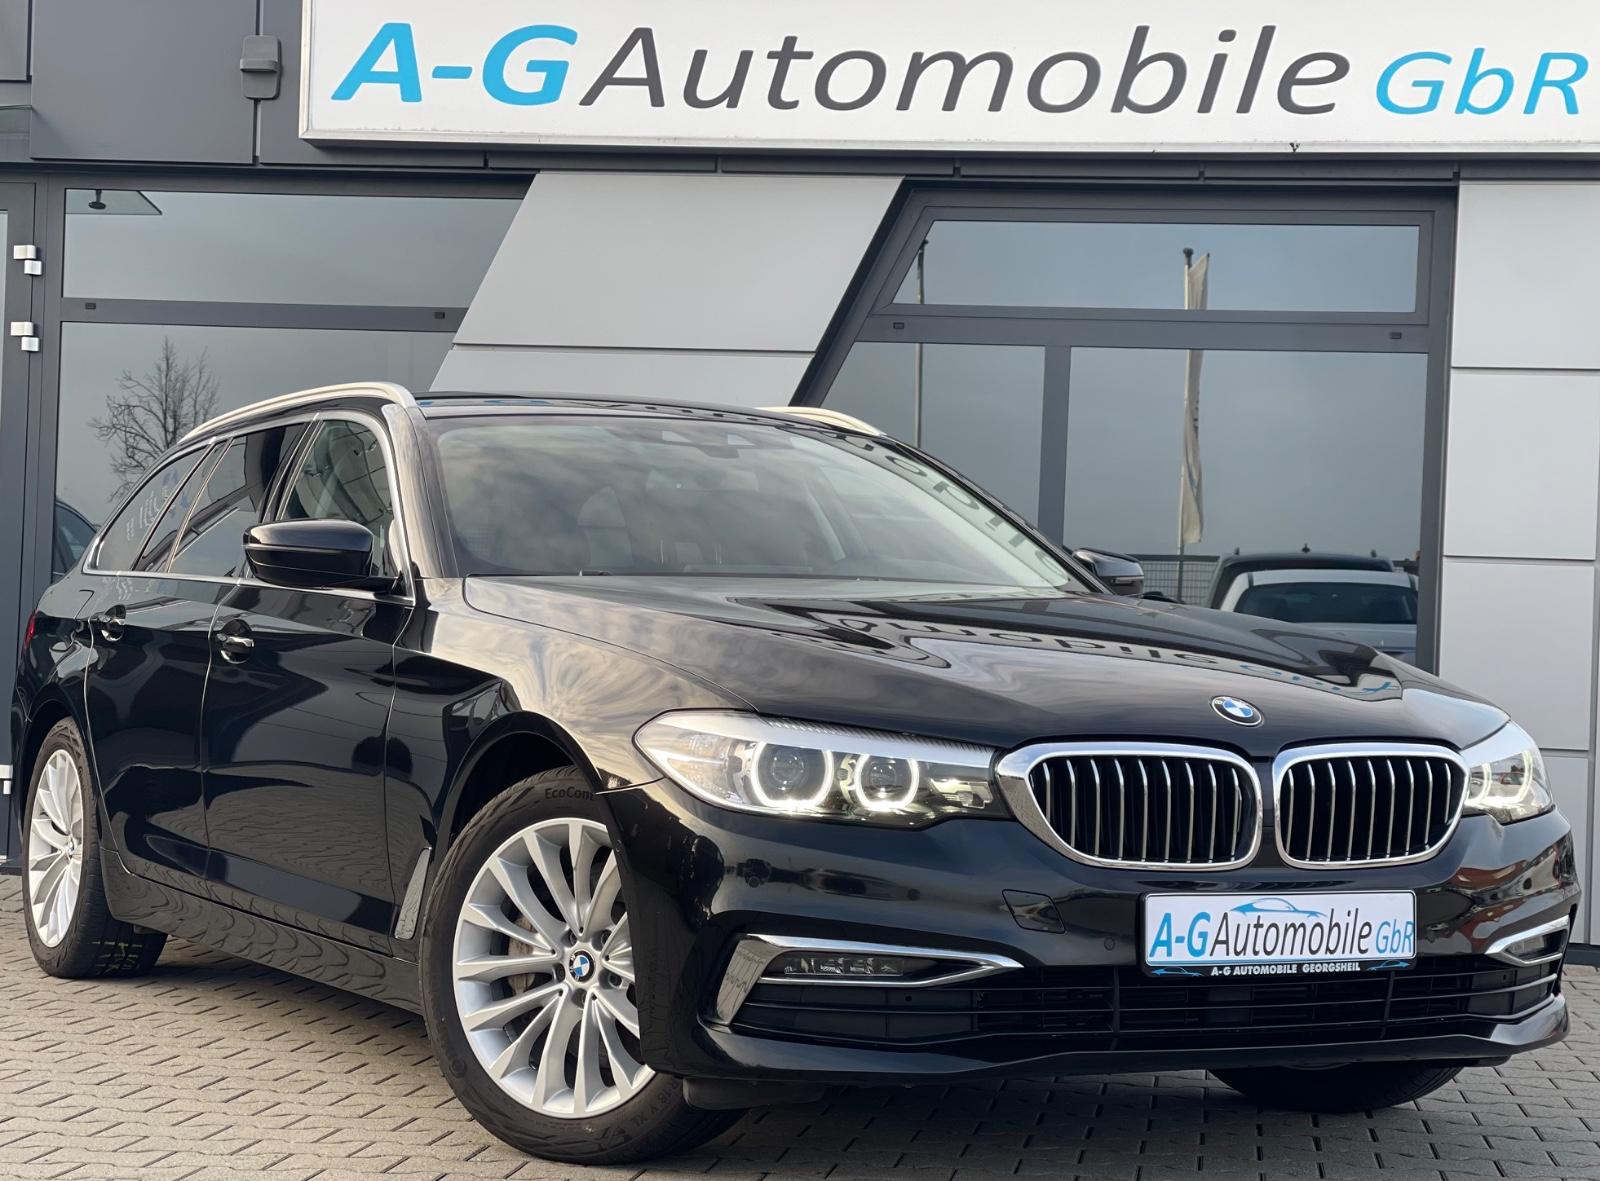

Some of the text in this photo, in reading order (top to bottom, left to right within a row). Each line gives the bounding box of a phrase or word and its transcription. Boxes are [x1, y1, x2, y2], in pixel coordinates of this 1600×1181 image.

[1376, 47, 1589, 115] GbR
[1375, 918, 1414, 954] GbR
[1211, 962, 1361, 976] A-G AUTOMOBILE GEORGSHEIL
